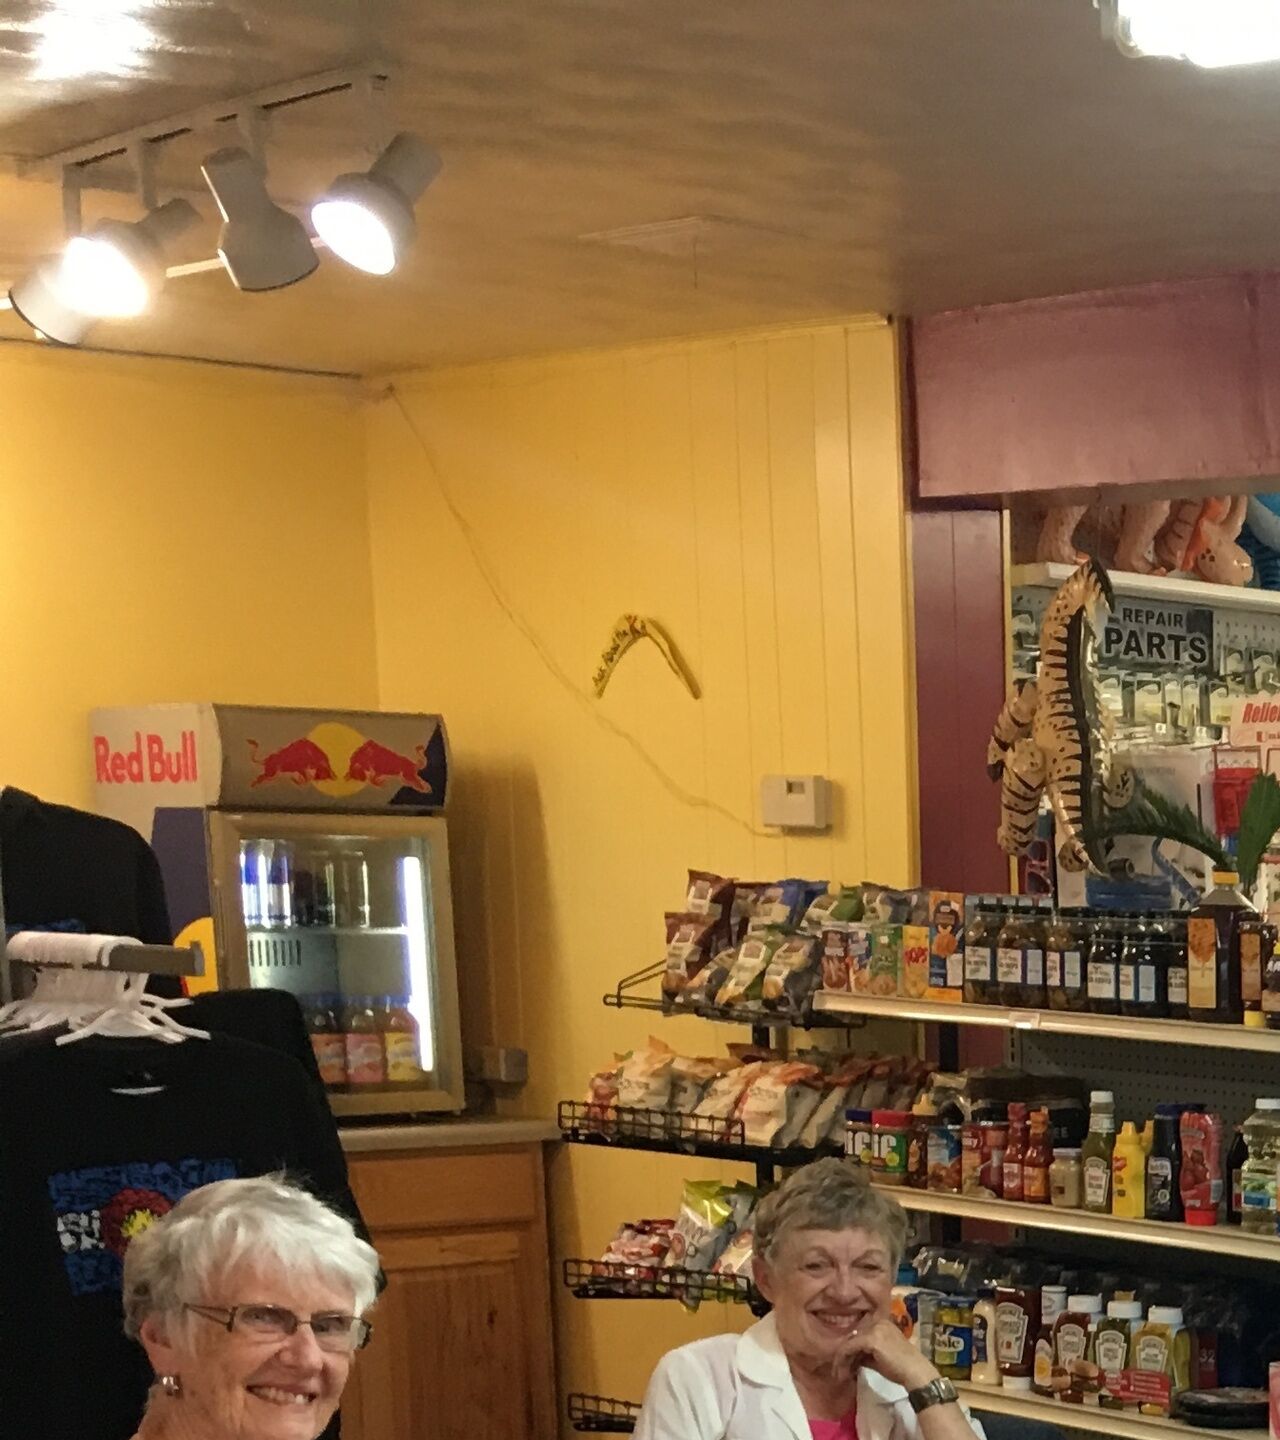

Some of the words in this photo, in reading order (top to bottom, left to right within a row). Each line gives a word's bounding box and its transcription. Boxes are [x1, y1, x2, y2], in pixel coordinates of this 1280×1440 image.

[1122, 607, 1184, 628] REPAIR
[1104, 626, 1208, 664] PARTS
[94, 730, 144, 784] Red
[146, 730, 198, 784] Bull
